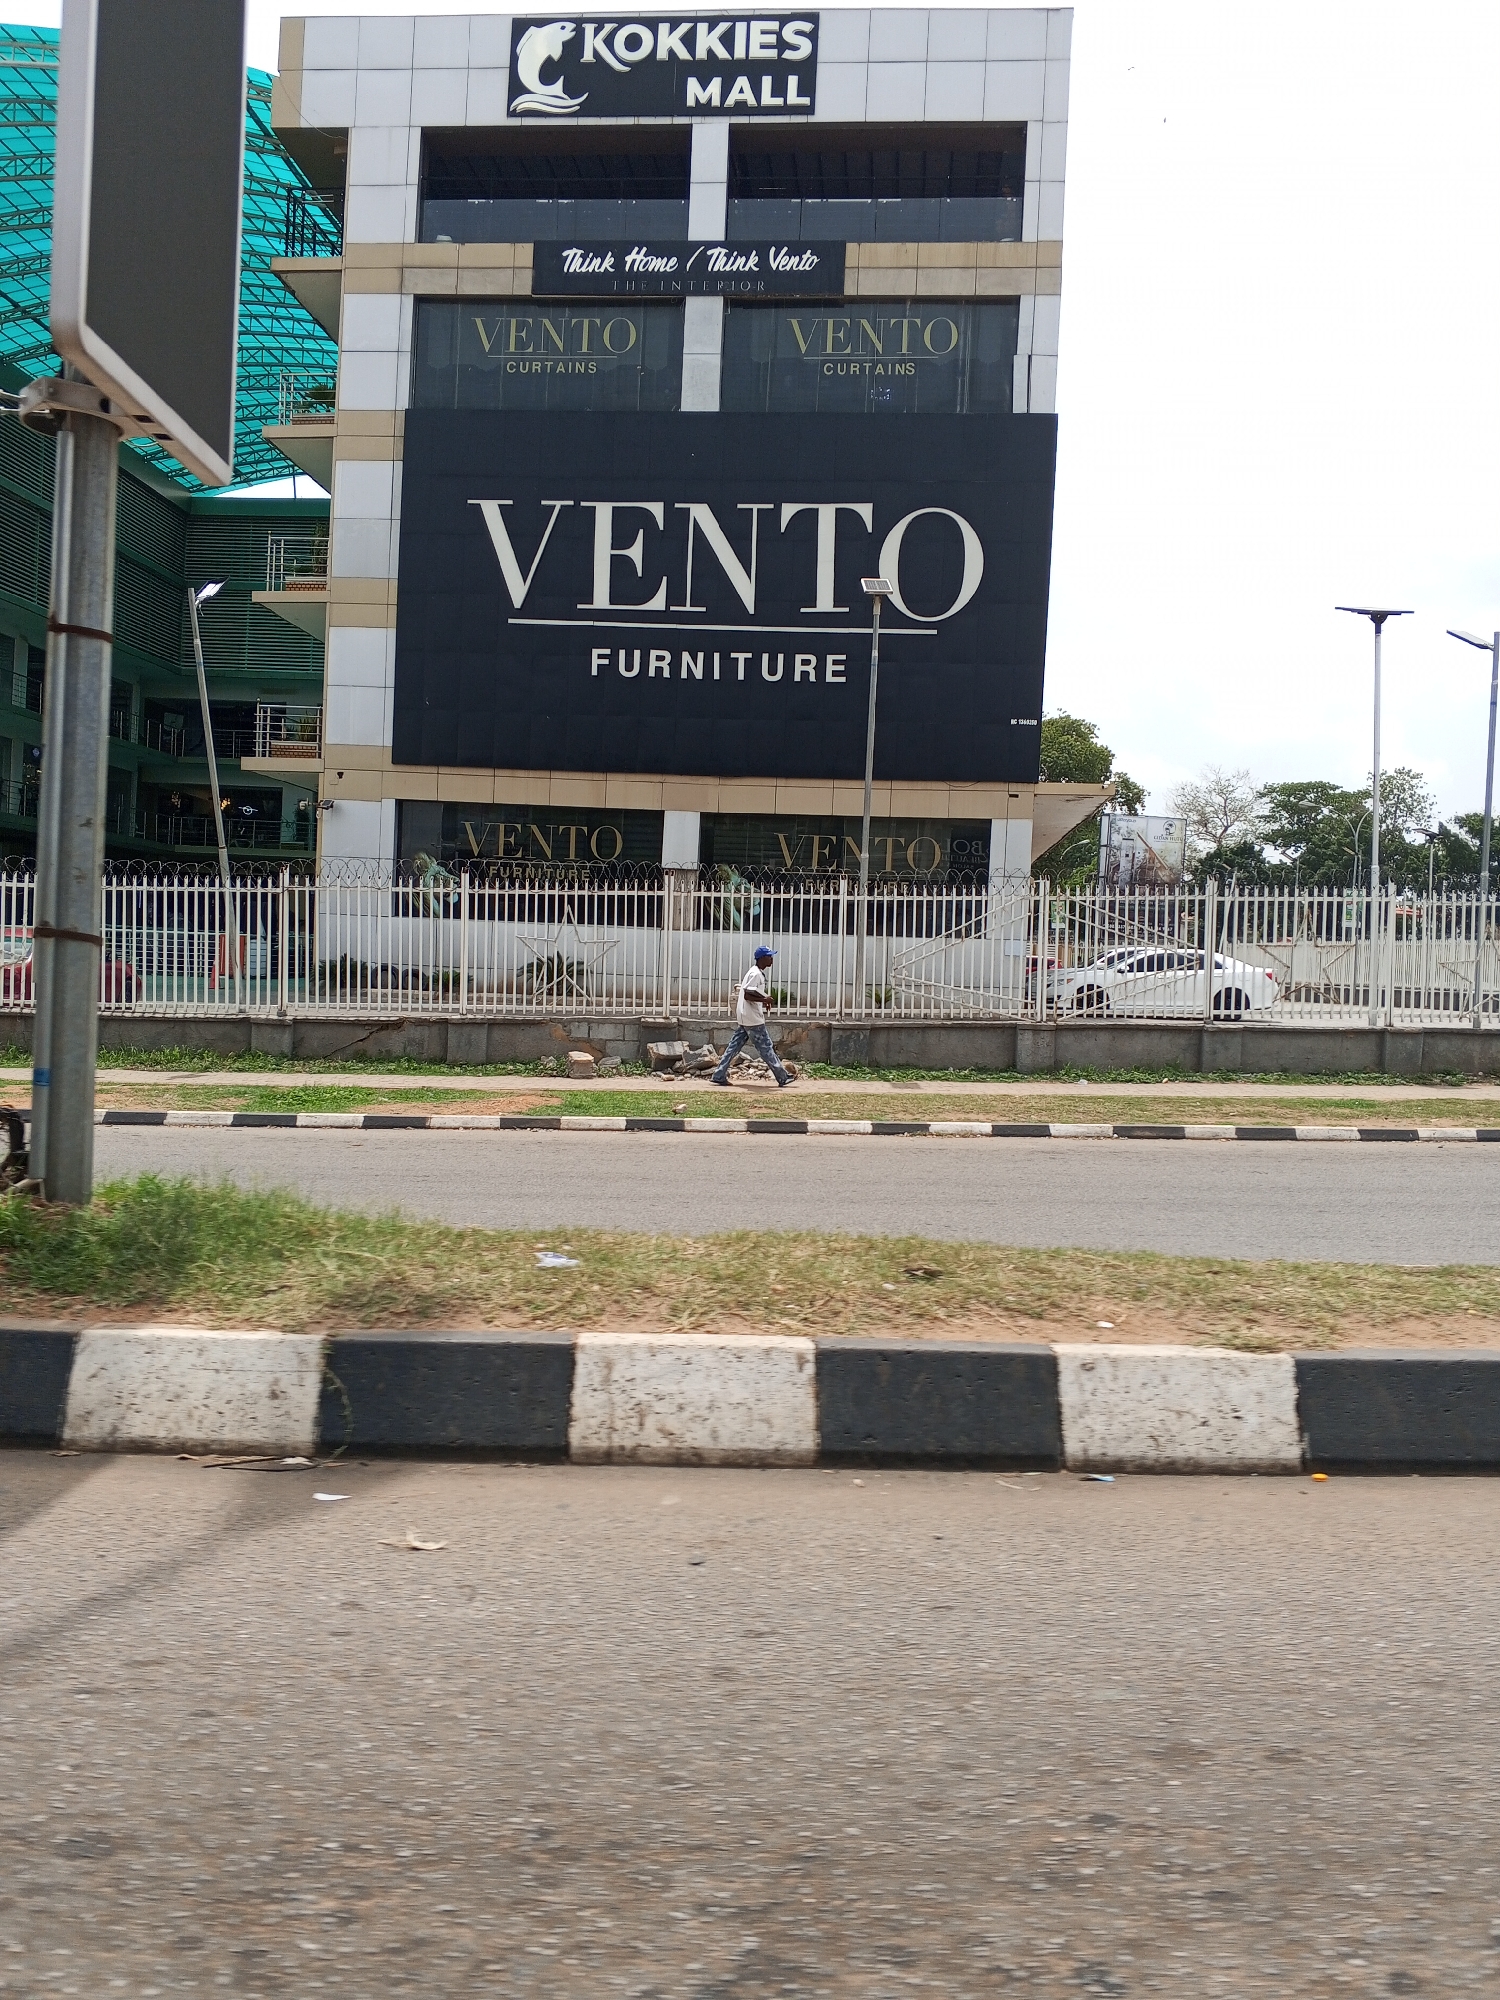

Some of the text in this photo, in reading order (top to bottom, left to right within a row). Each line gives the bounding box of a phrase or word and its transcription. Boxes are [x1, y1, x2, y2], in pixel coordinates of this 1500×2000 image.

[580, 20, 816, 72] KOKKIES
[686, 75, 811, 108] MALL
[561, 245, 821, 273] Think Home / Think Vento
[611, 280, 766, 291] THE INTERIOR
[470, 317, 637, 354] VENTO
[786, 317, 959, 355] VENTO
[506, 361, 598, 374] CURTAINS
[823, 362, 916, 375] CURTAINS
[466, 499, 985, 622] VENTO
[591, 648, 848, 683] FURNITURE
[461, 821, 624, 861] VENTO
[774, 833, 942, 872] VENTO
[488, 866, 591, 881] FURNITURE
